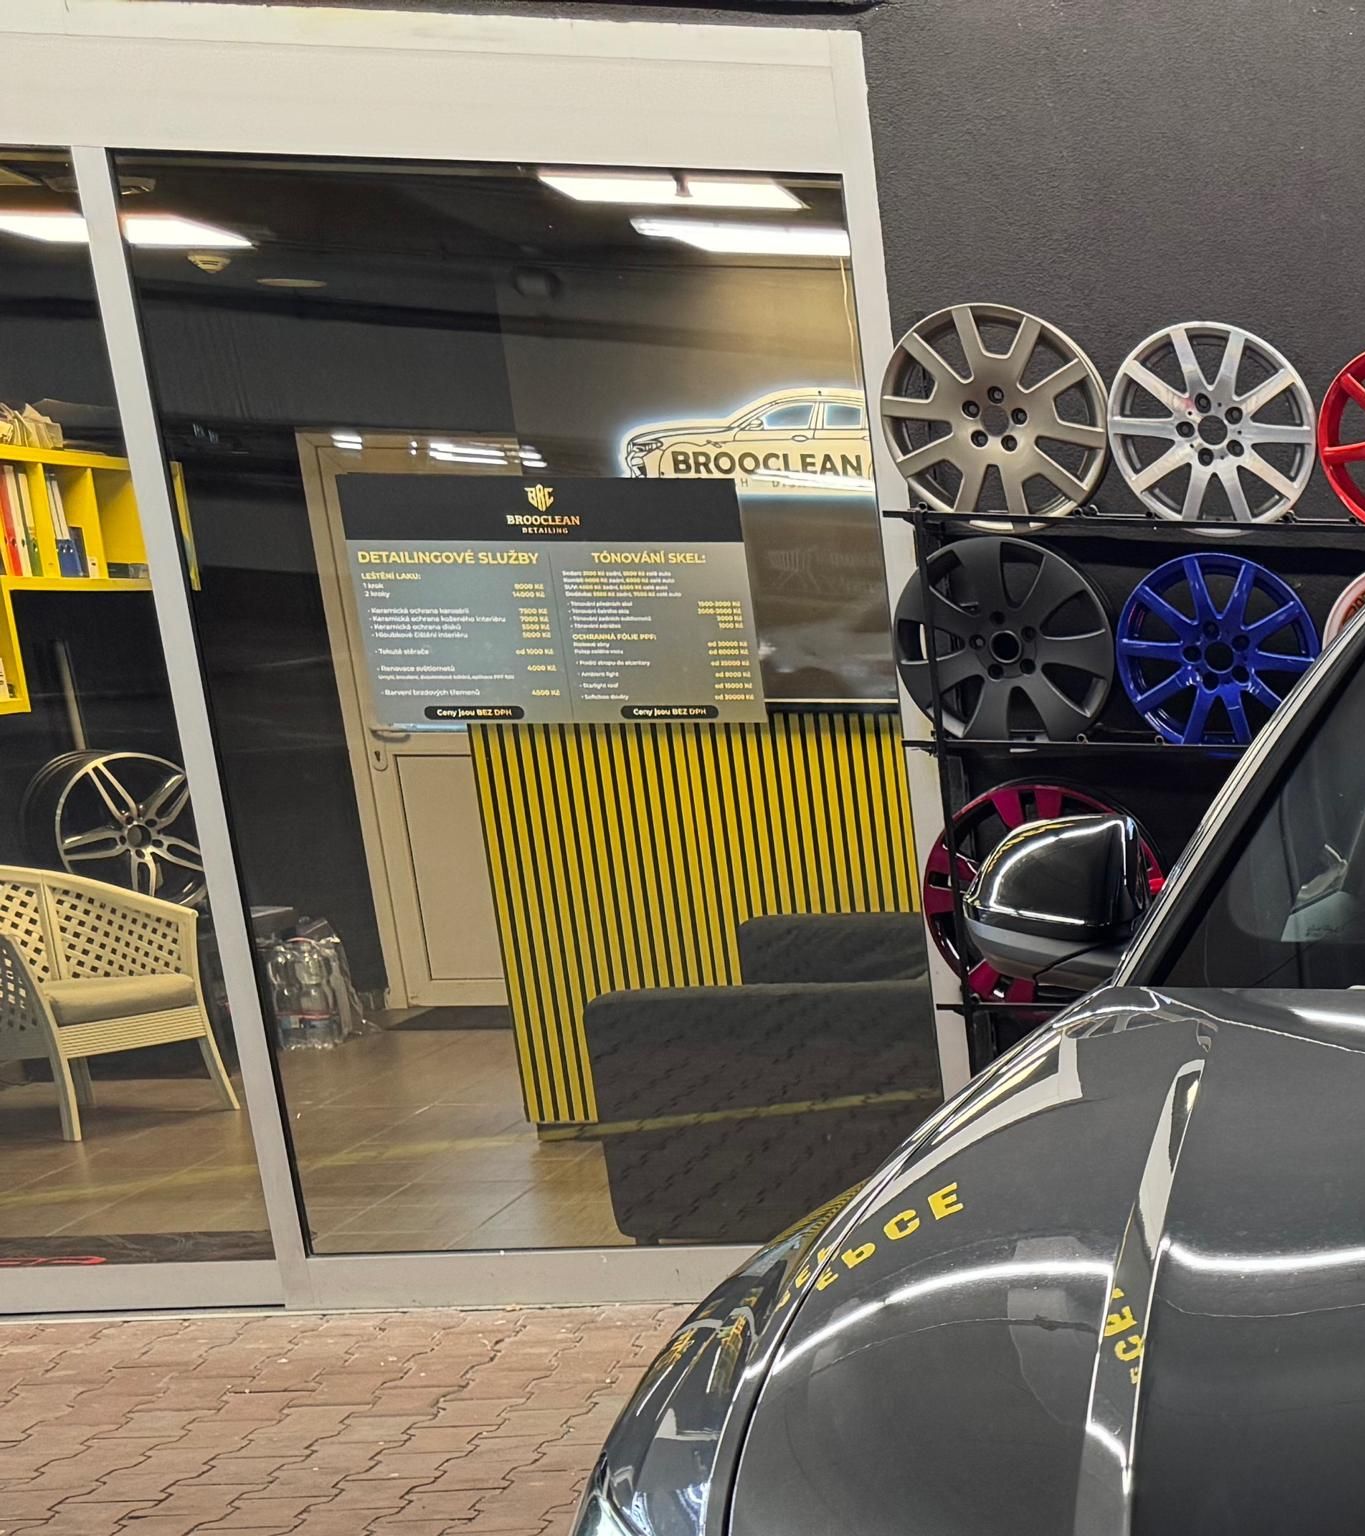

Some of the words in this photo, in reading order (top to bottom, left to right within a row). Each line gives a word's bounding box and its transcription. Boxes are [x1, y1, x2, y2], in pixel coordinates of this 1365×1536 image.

[671, 451, 862, 477] BROOCLEAN
[506, 515, 581, 526] BROOCLEAN
[522, 527, 568, 535] DETAILING
[358, 550, 475, 565] DETAILINGOVÉ
[478, 550, 539, 565] SLUŽBY
[591, 551, 664, 564] TÓNOVÁNÍ
[437, 709, 456, 718] Ceny
[458, 709, 475, 718] jsou
[476, 709, 494, 717] BEZ
[494, 709, 512, 717] DPH
[633, 708, 652, 717] Ceny
[654, 708, 671, 717] jsou
[672, 708, 688, 717] BEZ
[689, 708, 706, 717] DPH
